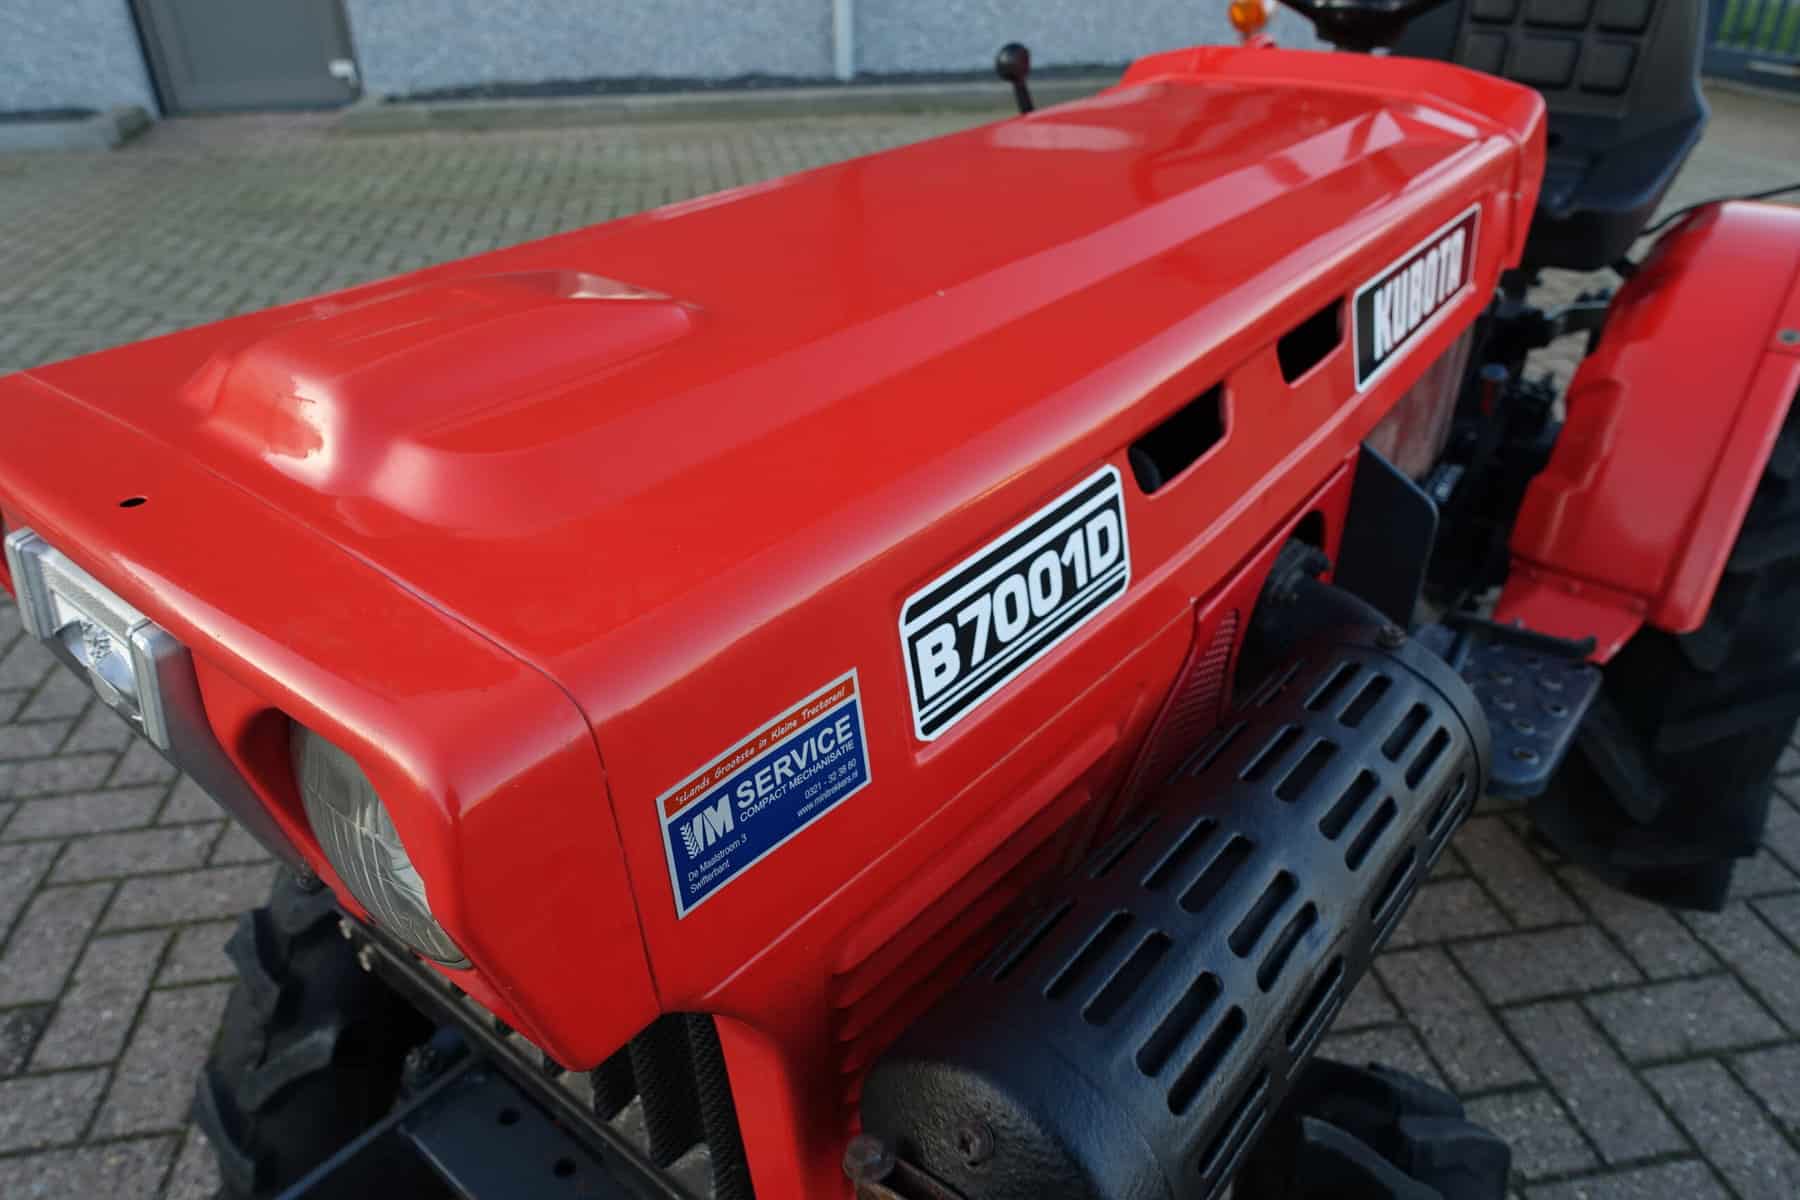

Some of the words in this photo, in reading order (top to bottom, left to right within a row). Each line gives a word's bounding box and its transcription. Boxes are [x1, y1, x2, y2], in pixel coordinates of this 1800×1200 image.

[1373, 228, 1466, 361] KUBOTA
[915, 509, 1120, 701] B7001D
[715, 747, 755, 778] Grootste
[759, 738, 767, 748] in
[771, 720, 797, 741] Kleine
[736, 715, 853, 808] SERVICE
[739, 787, 788, 823] COMPACT
[789, 739, 855, 792] MECHANISATIE
[688, 868, 699, 881] De
[699, 839, 741, 870] Maalstroom
[741, 833, 748, 844] 3
